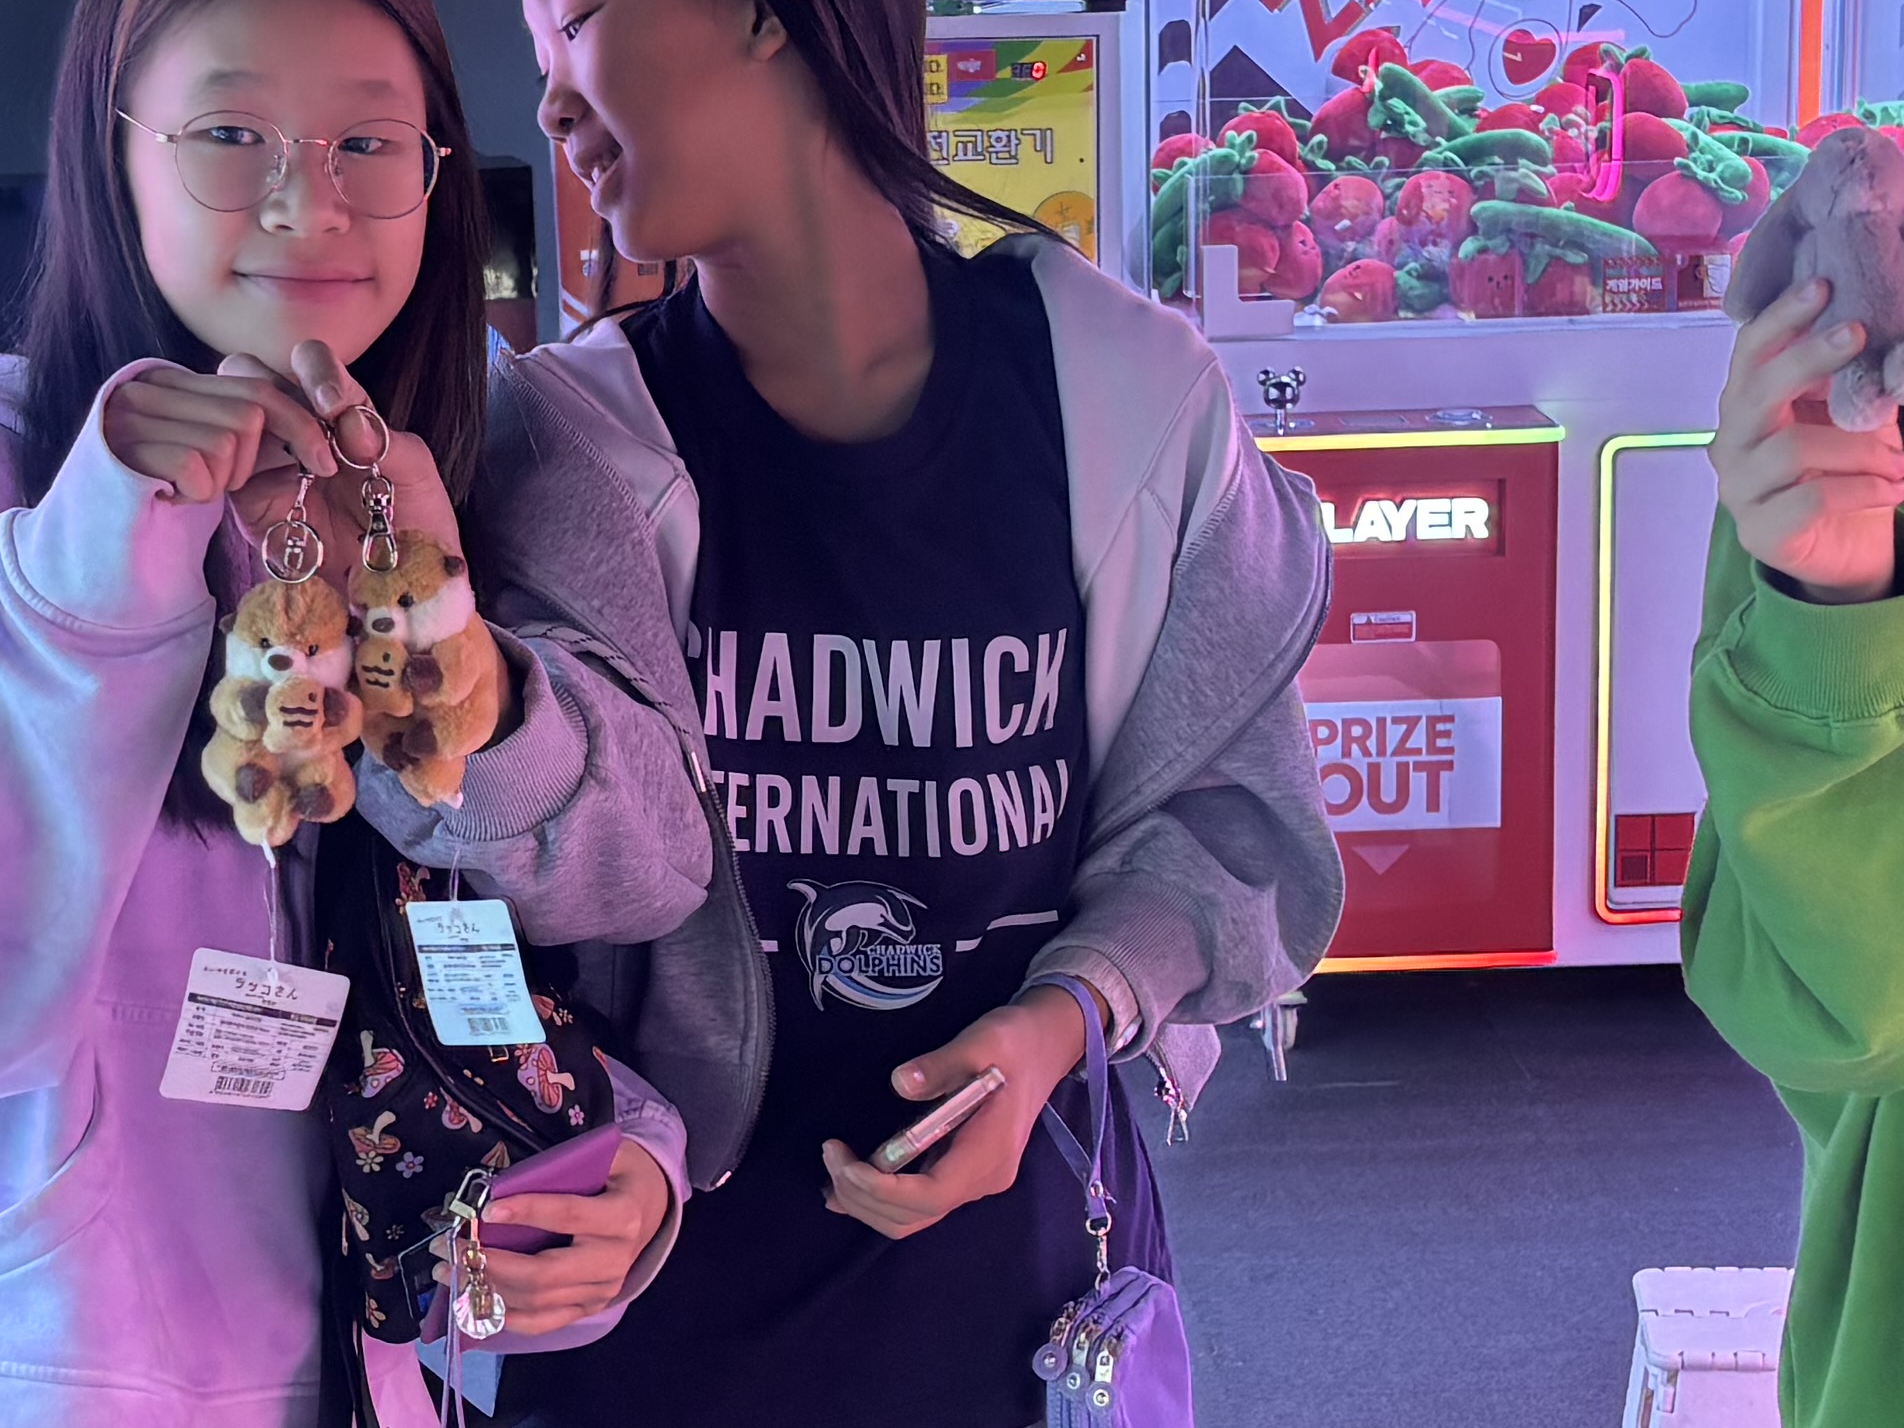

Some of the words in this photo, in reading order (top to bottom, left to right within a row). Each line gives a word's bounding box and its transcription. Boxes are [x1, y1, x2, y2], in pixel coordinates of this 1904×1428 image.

[1320, 498, 1490, 544] LAYER
[1314, 714, 1455, 758] PRIZE
[1322, 760, 1455, 816] OUT
[816, 953, 943, 977] DOLPHINS
[866, 944, 942, 956] CHADWICK
